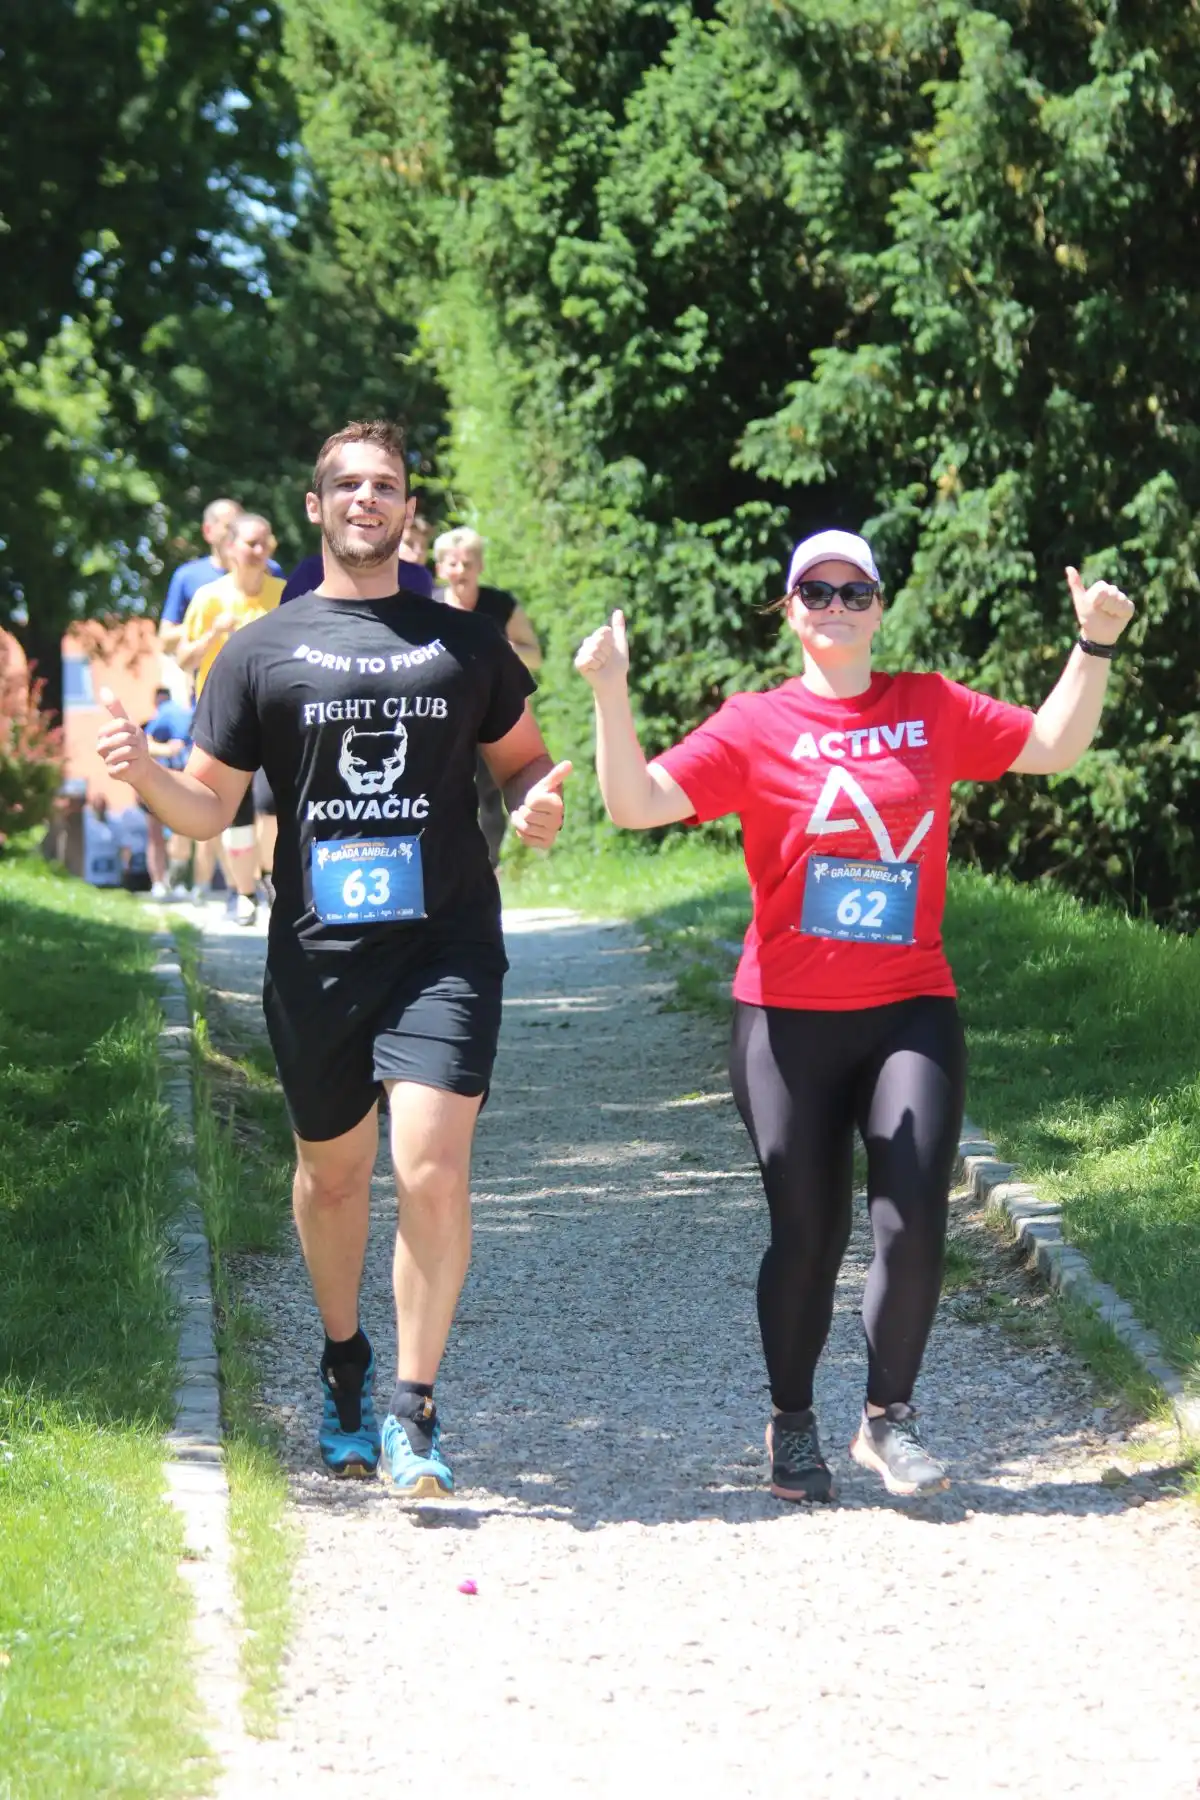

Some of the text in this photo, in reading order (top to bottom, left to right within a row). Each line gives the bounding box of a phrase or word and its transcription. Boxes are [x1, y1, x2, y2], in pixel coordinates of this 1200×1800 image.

[293, 638, 447, 674] BORN TO FIGHT
[304, 696, 449, 725] FIGHT CLUB
[790, 719, 928, 760] ACTIVE
[307, 793, 431, 822] KOVAČIĆ
[342, 867, 391, 908] 63
[831, 867, 862, 879] GRADA
[836, 887, 887, 928] 62
